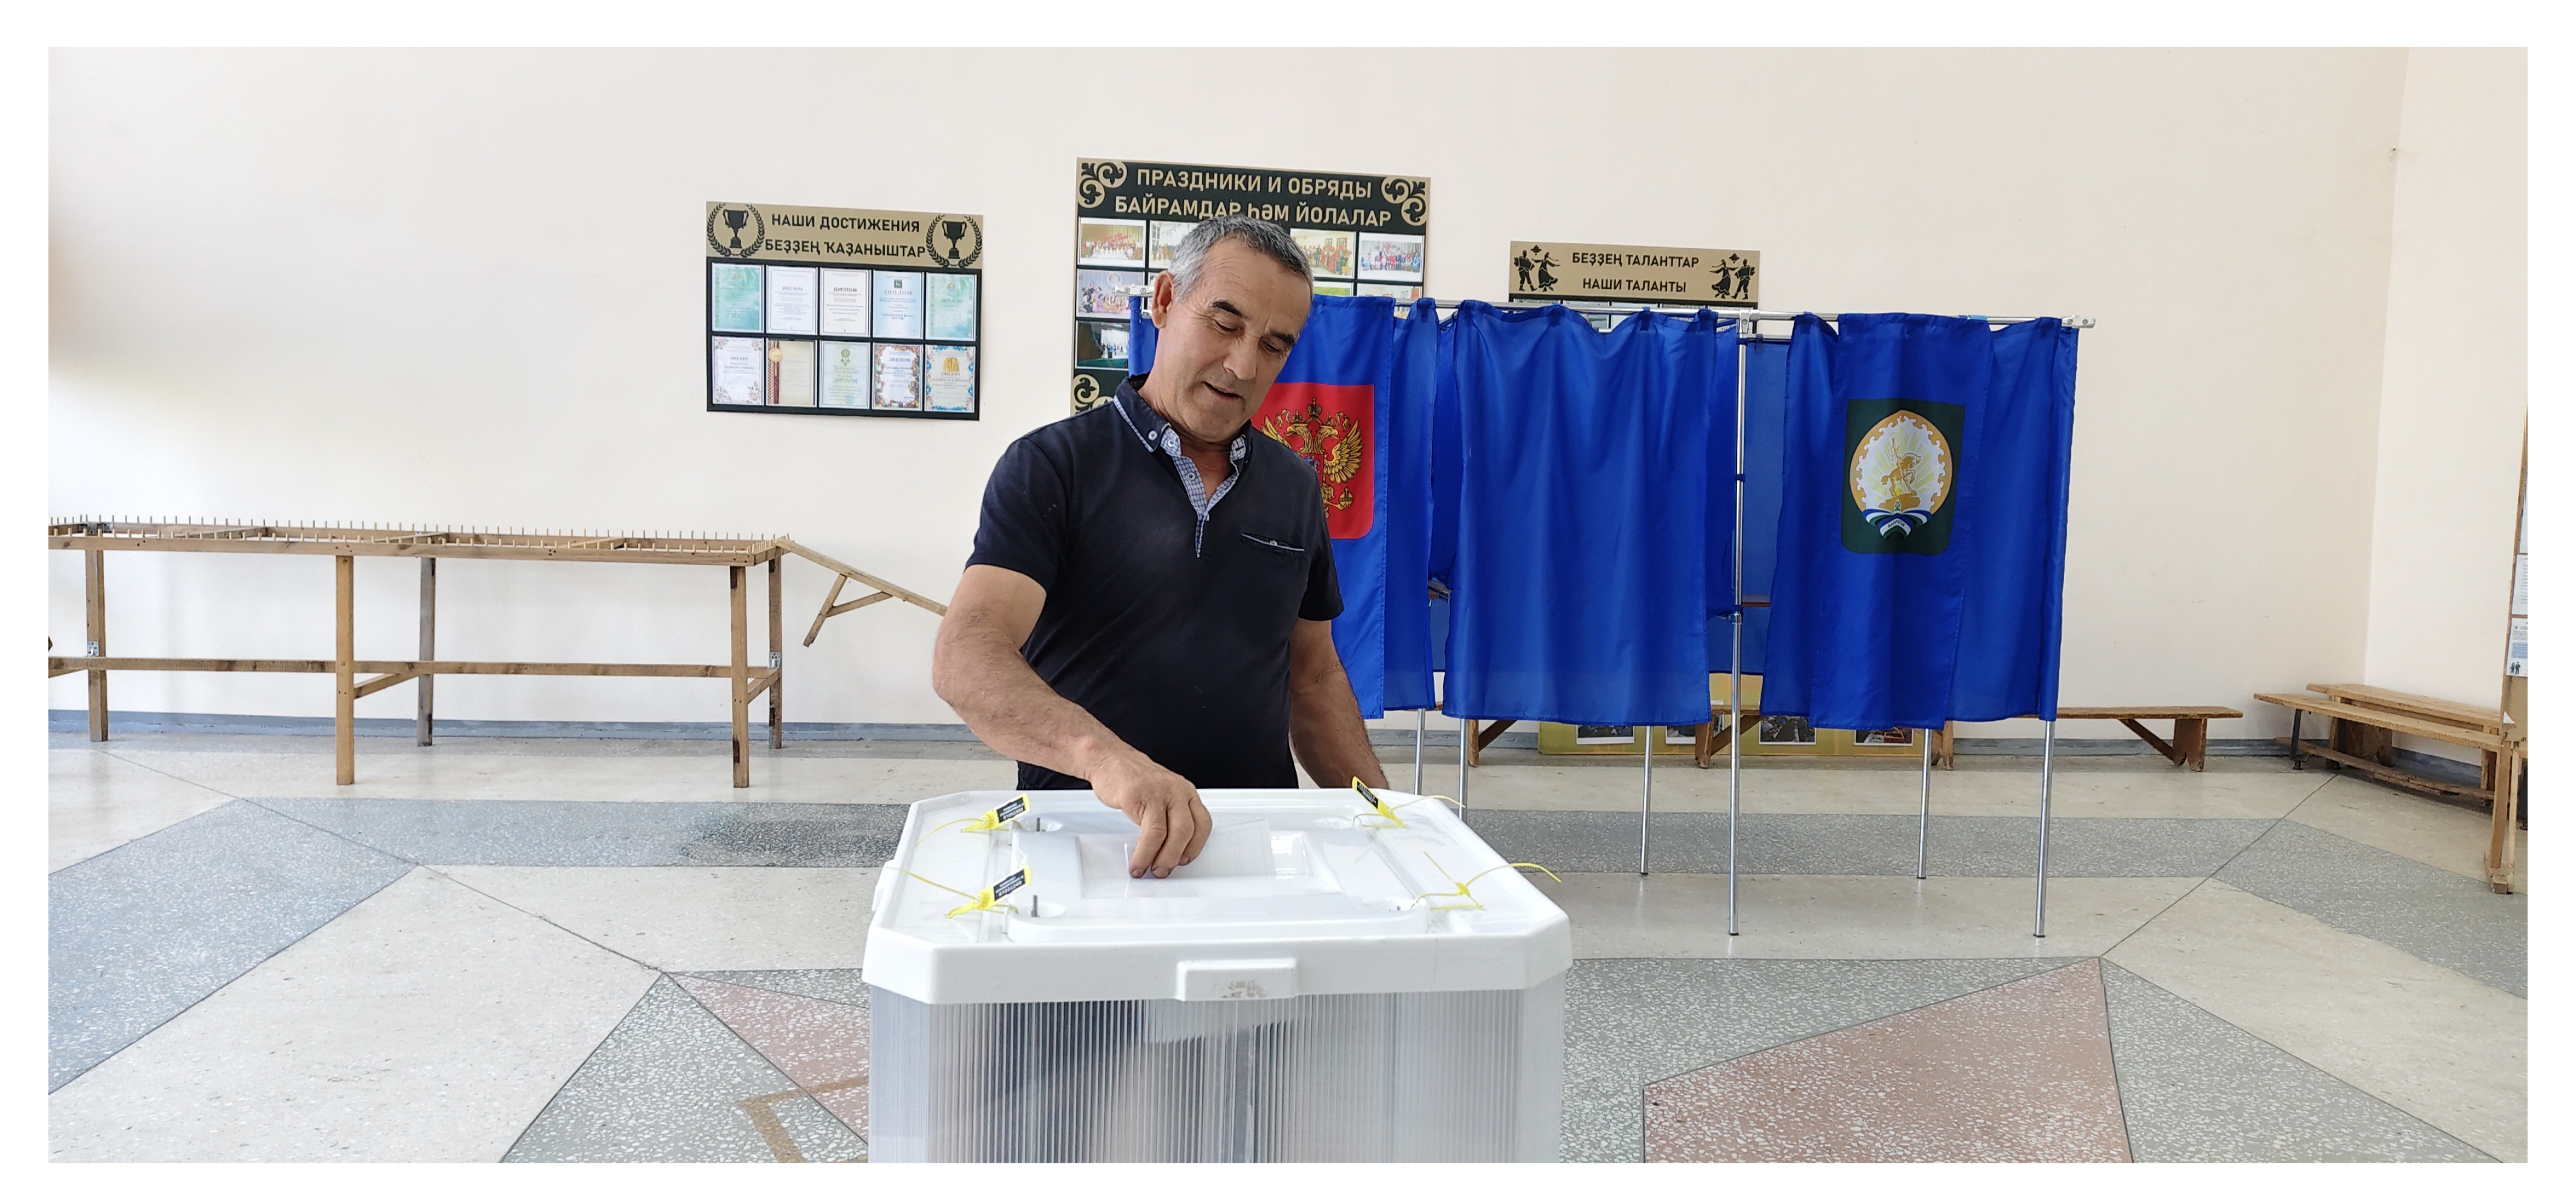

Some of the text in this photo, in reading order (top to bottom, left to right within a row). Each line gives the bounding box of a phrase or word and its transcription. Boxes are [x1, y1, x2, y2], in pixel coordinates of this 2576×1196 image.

[1137, 168, 1372, 201] ПРАЗДНИКИ И ОБРЯДЫ
[1115, 192, 1242, 220] БАЙРАМДАР
[1295, 201, 1392, 227] ЙОЛАЛАР
[771, 214, 920, 233] НАШИ ДОСТИЖЕНИЯ
[1625, 254, 1700, 269] ТАЛАНТТАР
[1582, 277, 1686, 293] НАШИ ТАЛАНТЫ
